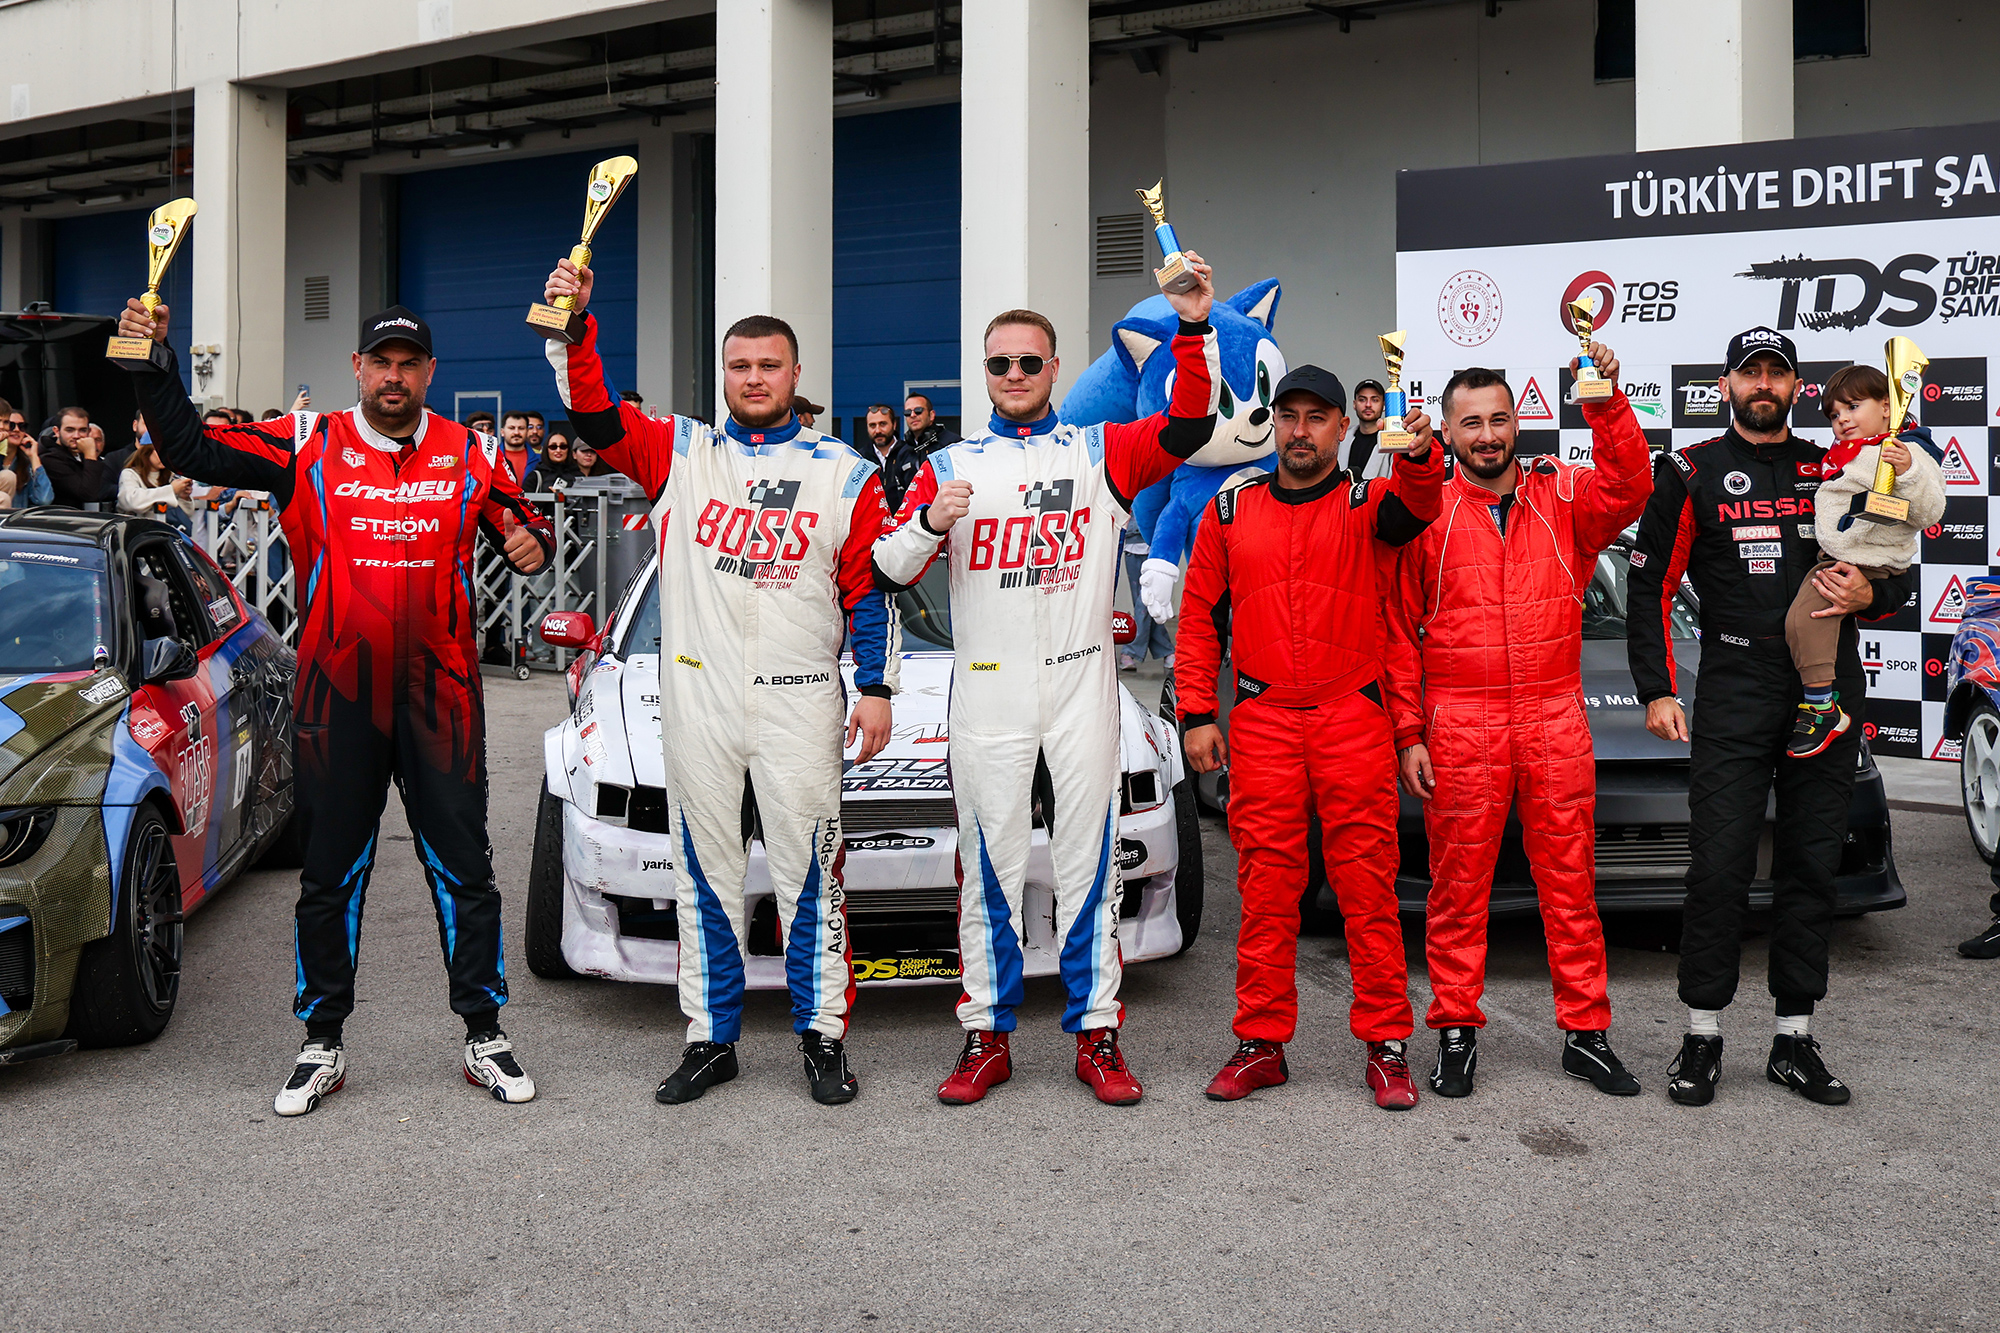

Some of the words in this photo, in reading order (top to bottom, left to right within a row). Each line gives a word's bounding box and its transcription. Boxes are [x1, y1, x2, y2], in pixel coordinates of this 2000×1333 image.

[1605, 165, 1780, 219] TÜRKİYE
[1792, 158, 1923, 208] DRIFT
[1934, 153, 2000, 209] ŞA
[1623, 280, 1679, 301] TOS
[1943, 275, 2000, 296] DRIF
[1621, 303, 1677, 324] FED
[1940, 295, 2000, 324] ŞAM
[1741, 330, 1782, 346] NGK
[1624, 382, 1661, 397] Drift
[1942, 385, 1984, 395] REISS
[1717, 498, 1816, 522] NISSA
[351, 516, 440, 533] STRÖM
[695, 498, 819, 561] BOSS
[1943, 524, 1985, 533] REISS
[969, 507, 1091, 571] BOSS
[1735, 527, 1779, 539] MOTUL
[353, 558, 436, 567] TRI-ACE
[1631, 552, 1647, 564] NGK
[1751, 560, 1773, 569] NGK
[754, 564, 800, 580] RACING
[1039, 564, 1081, 585] RACING
[756, 582, 773, 590] DRIFT
[774, 581, 792, 590] TEAM
[1044, 585, 1060, 595] DRIFT
[1060, 582, 1076, 593] TEAM
[545, 619, 570, 632] NGK
[678, 655, 701, 669] Sabelt
[1045, 657, 1056, 666] D.
[1057, 644, 1101, 664] BOSTAN
[971, 662, 998, 671] Sabelt
[1886, 660, 1917, 671] SPOR
[753, 676, 769, 685] A.
[771, 673, 830, 685] BOSTAN
[1878, 726, 1919, 737] REISS
[850, 838, 929, 848] TOSFED
[828, 918, 843, 954] A&C
[851, 958, 898, 980] DS
[899, 967, 961, 977] ŞAMPİYONA
